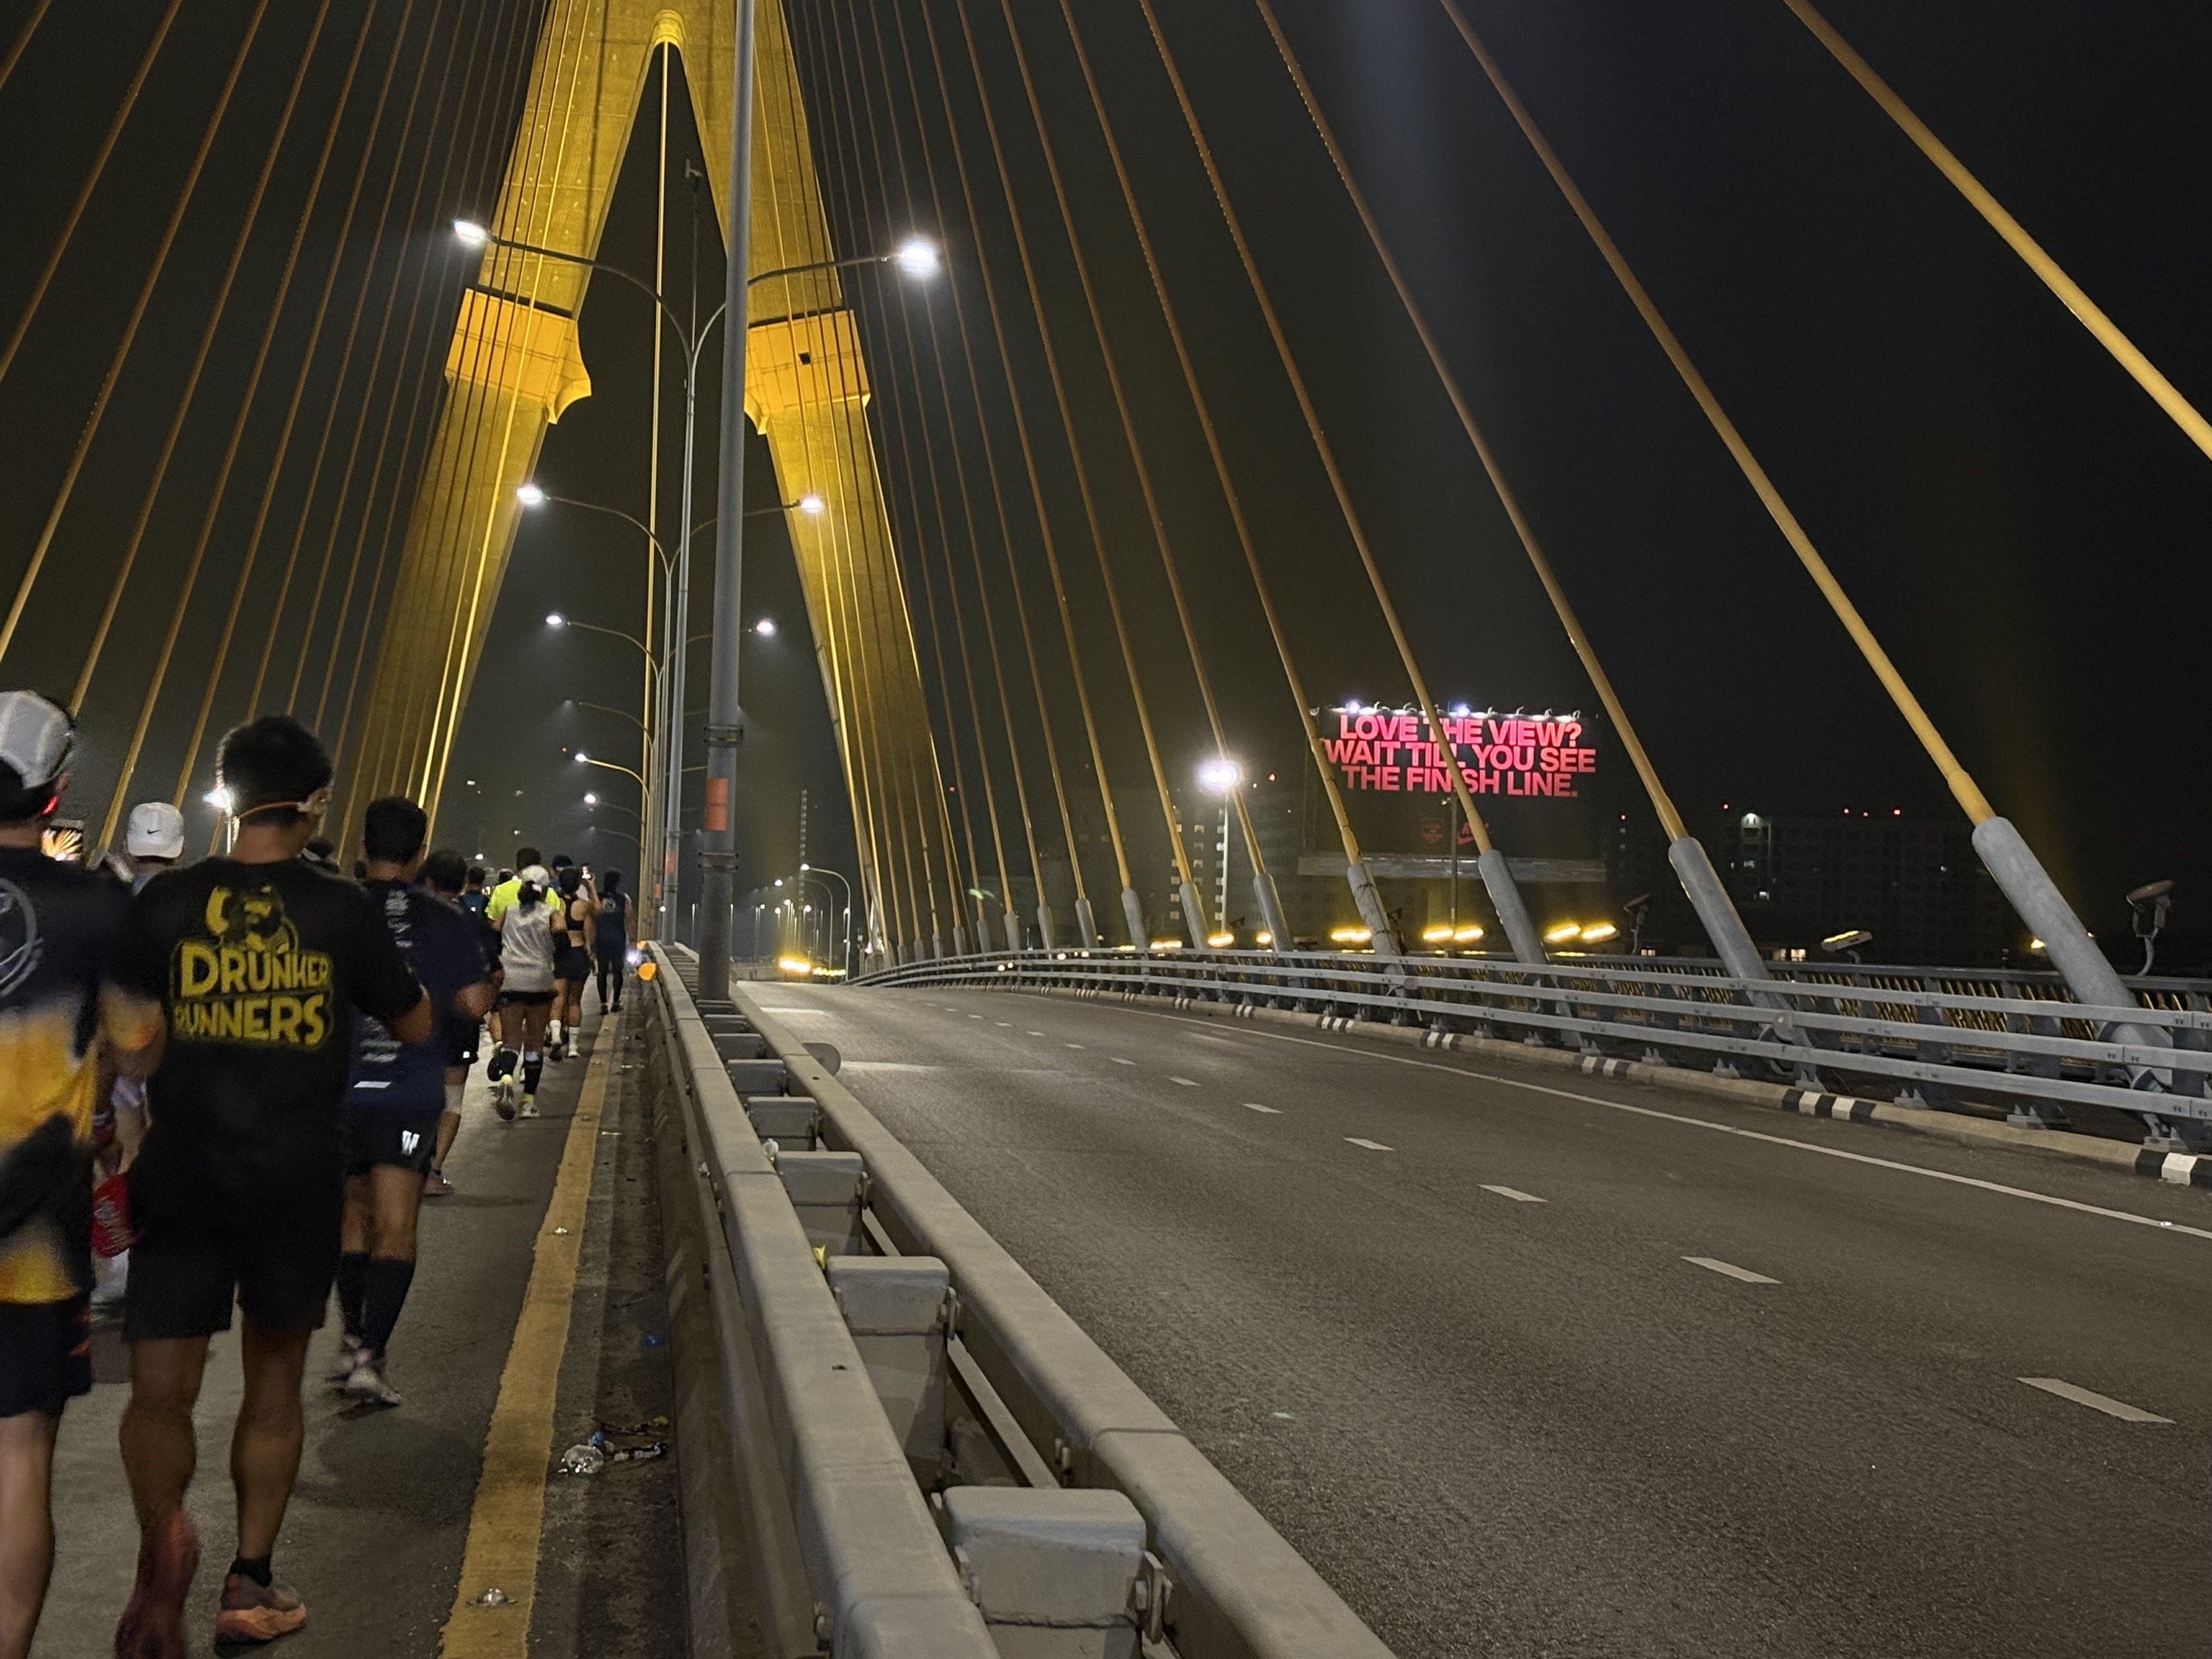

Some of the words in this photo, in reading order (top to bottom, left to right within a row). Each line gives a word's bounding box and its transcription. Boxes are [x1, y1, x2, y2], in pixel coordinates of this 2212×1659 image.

[1340, 715, 1419, 741] LOVE
[1423, 716, 1483, 744] THE
[1488, 720, 1582, 747] VIEW?
[1325, 740, 1401, 765] WAIT
[1471, 744, 1534, 771] YOU
[1539, 747, 1596, 772] SEE
[1341, 765, 1400, 791] THE
[1407, 768, 1499, 794] FINSH
[1507, 771, 1578, 797] LINE.
